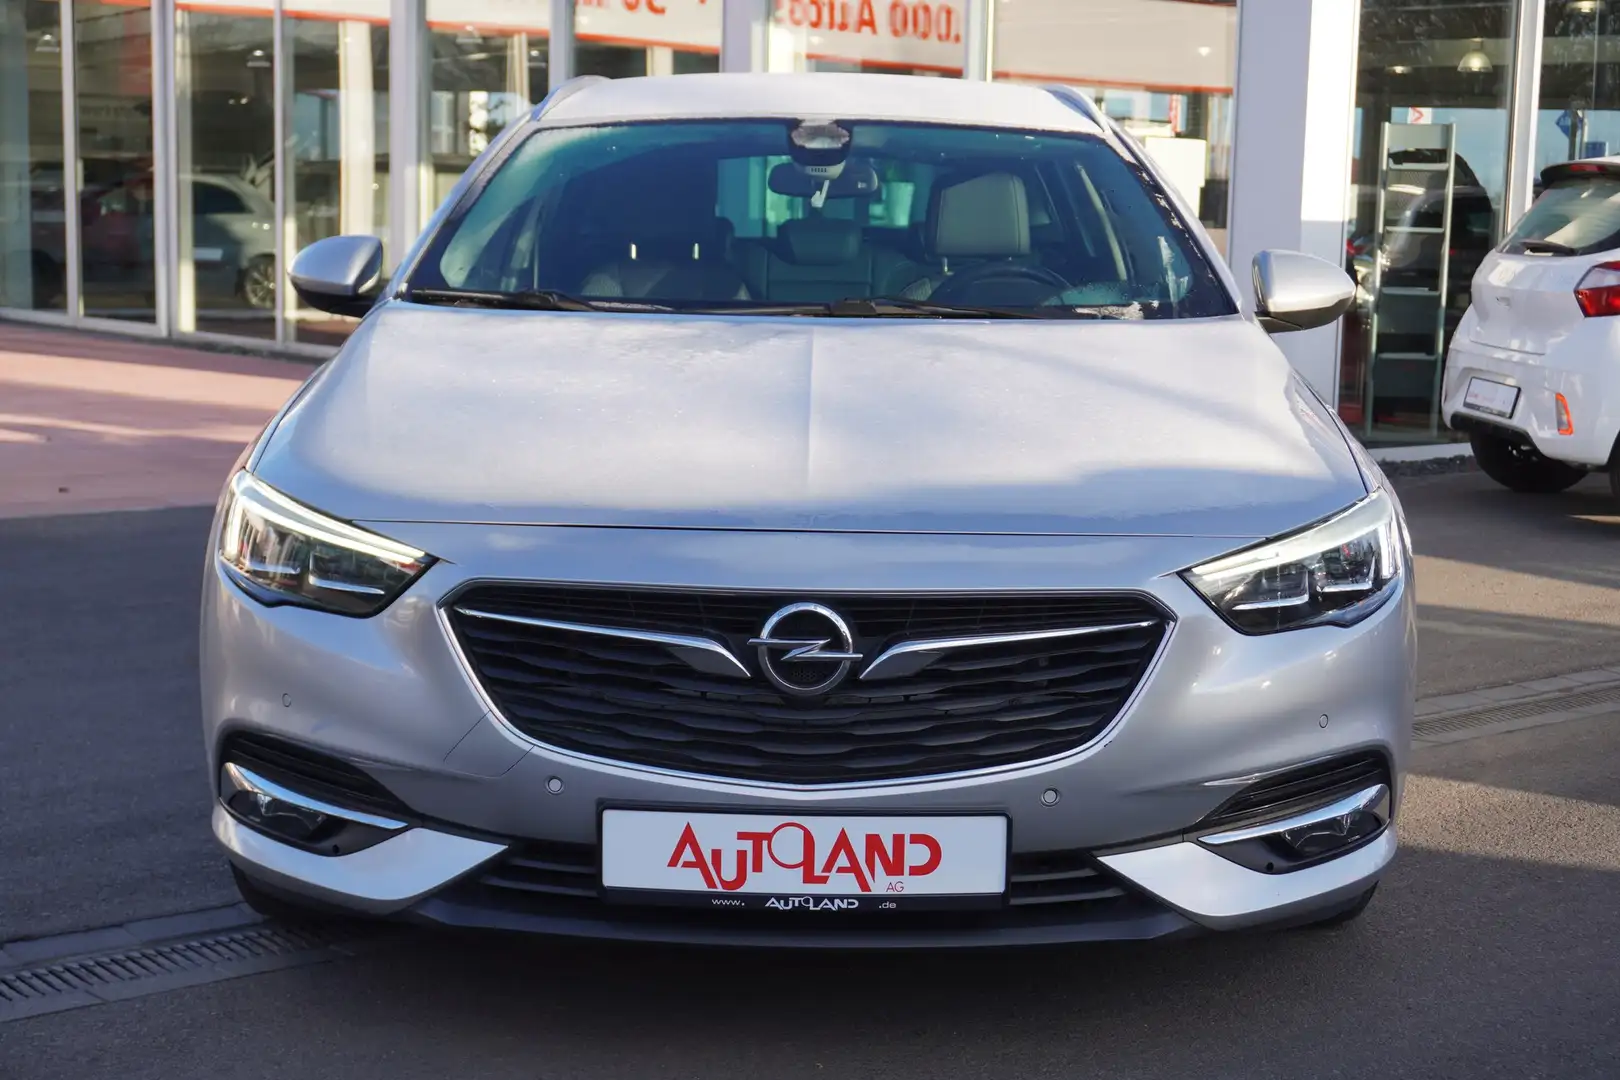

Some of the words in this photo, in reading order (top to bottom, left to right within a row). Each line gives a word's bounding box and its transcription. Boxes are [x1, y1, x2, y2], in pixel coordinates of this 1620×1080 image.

[667, 821, 942, 892] AUTOLAND
[886, 881, 905, 893] AG
[711, 898, 745, 906] www.
[765, 896, 859, 911] AUTOLAND
[878, 901, 897, 909] .de
